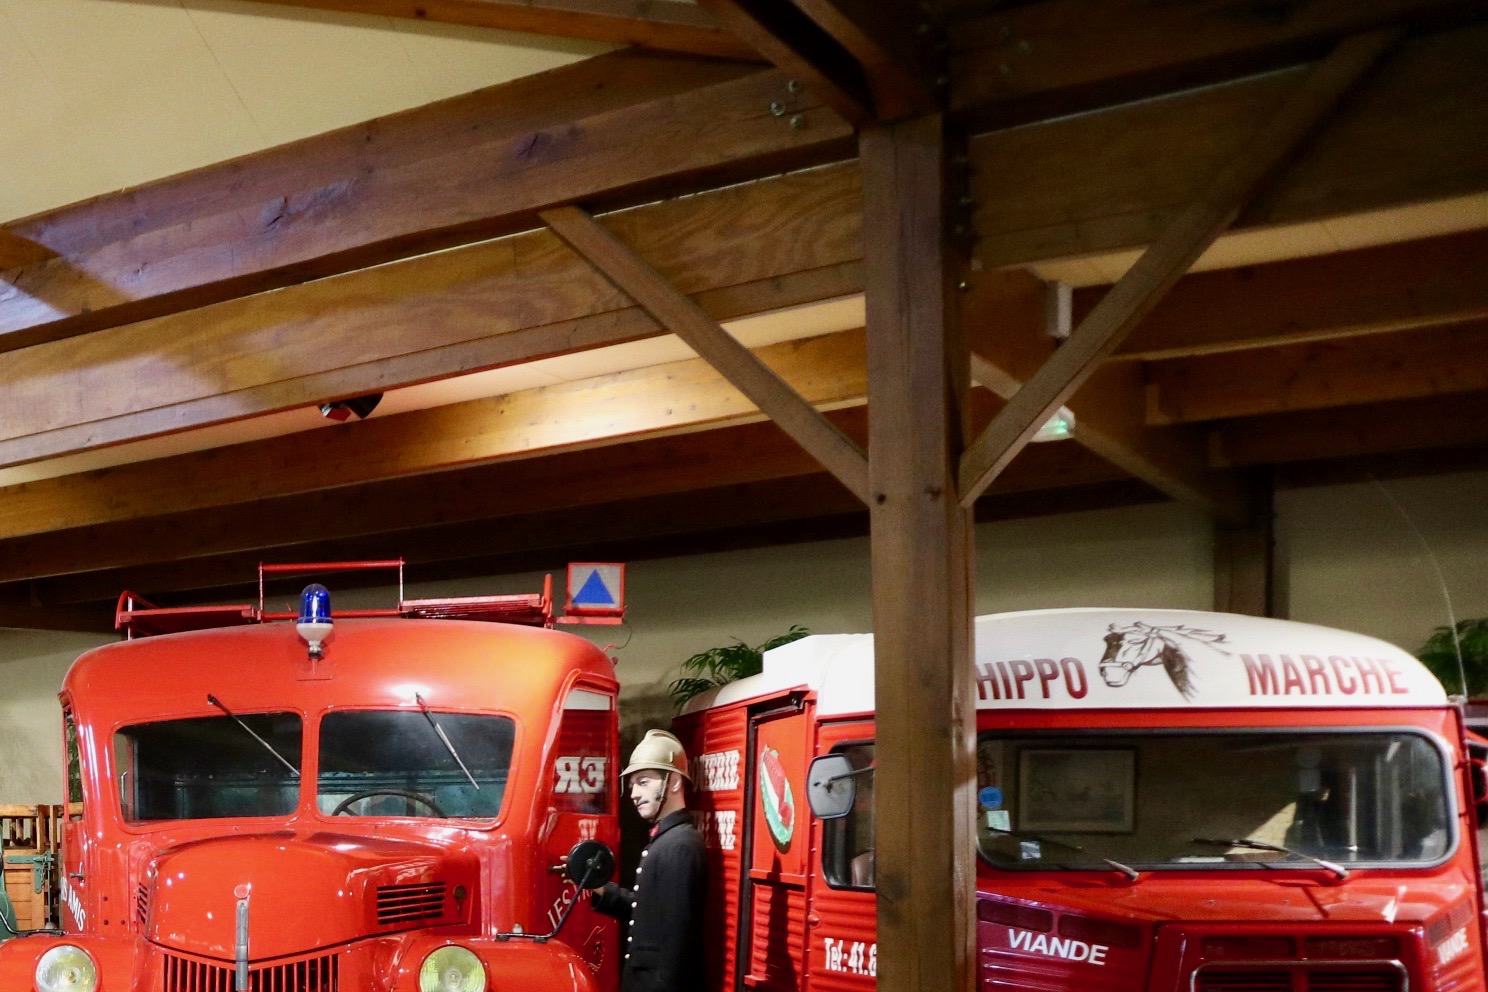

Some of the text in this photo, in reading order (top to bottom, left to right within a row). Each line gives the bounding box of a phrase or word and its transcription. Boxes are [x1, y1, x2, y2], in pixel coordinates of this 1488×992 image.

[975, 652, 1410, 700] HIPPO MARCHE
[1008, 928, 1109, 966] VIANDE
